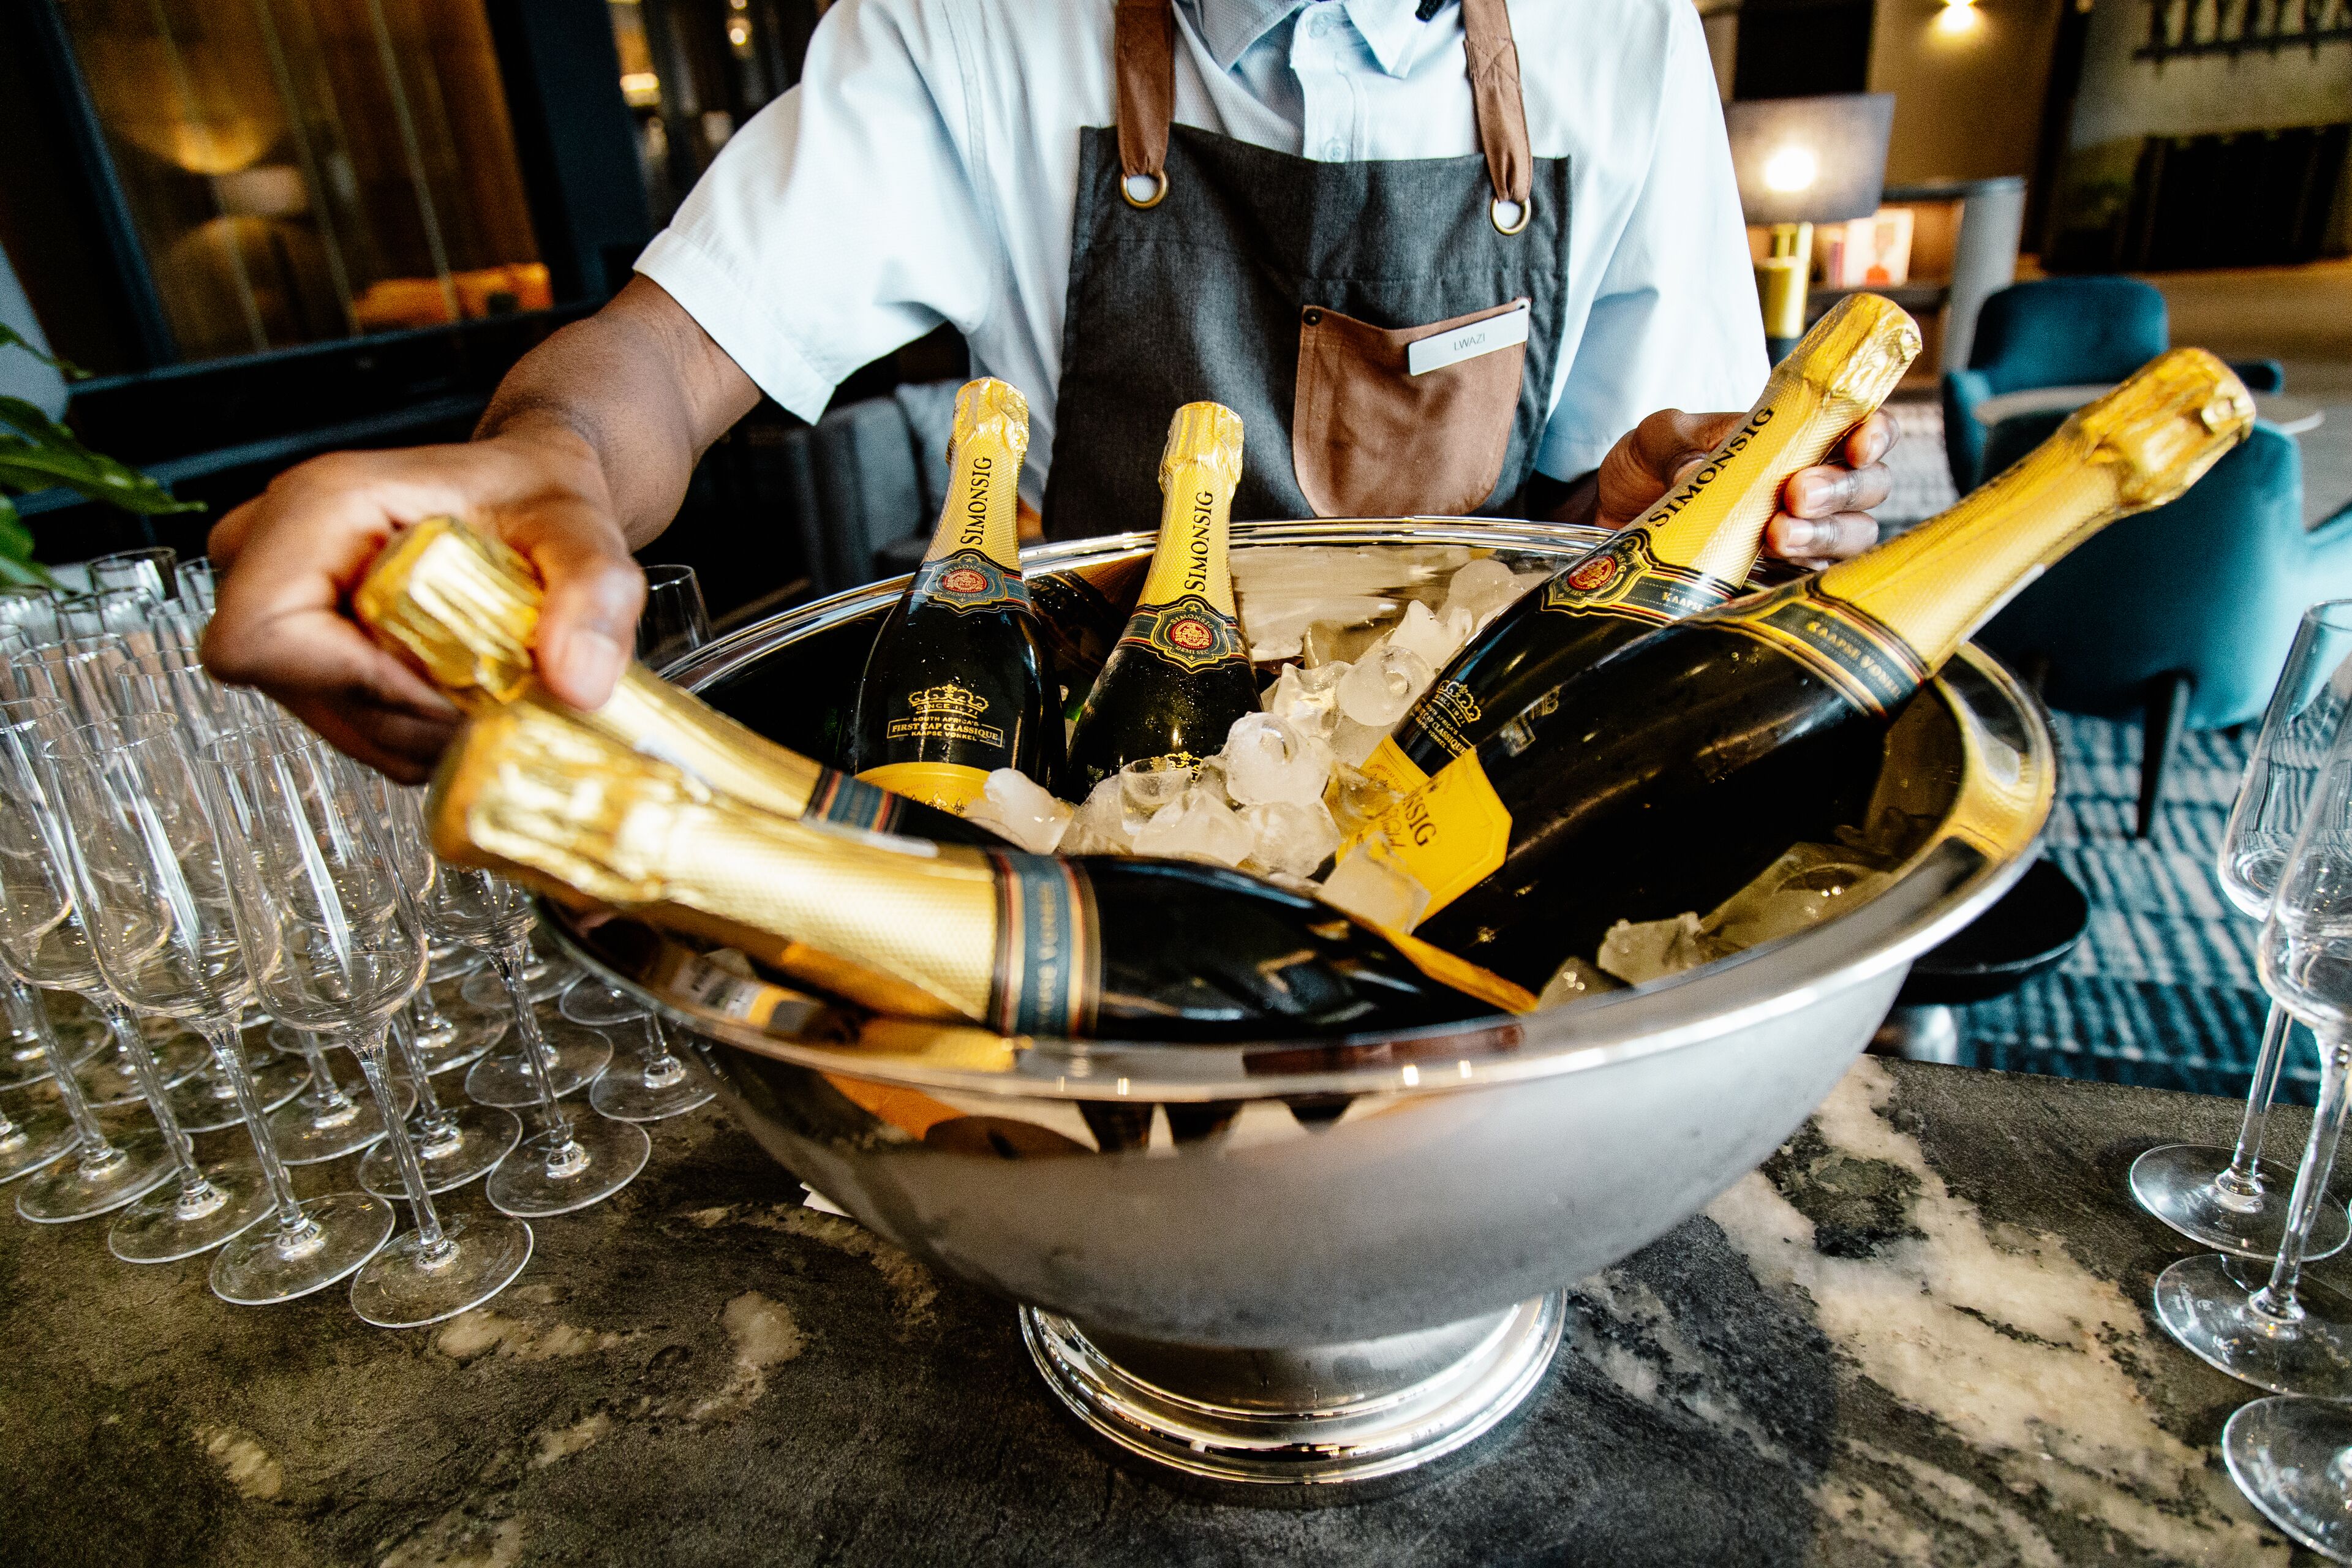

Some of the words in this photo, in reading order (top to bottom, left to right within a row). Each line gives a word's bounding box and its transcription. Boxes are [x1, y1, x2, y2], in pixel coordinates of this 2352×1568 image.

[1453, 333, 1485, 351] LWAZI
[1648, 407, 1774, 527] SIMONSIG
[960, 456, 992, 545] SIMONSIG
[1184, 490, 1213, 592] SIMONSIG
[1662, 591, 1704, 612] KAAPSE
[1170, 613, 1215, 630] SIMONSIG
[1175, 646, 1194, 655] DEMI
[892, 723, 920, 733] FIRST
[943, 723, 998, 740] CLASSIQUE
[945, 732, 977, 741] VONKEL
[1432, 722, 1468, 755] CLASSIQUE
